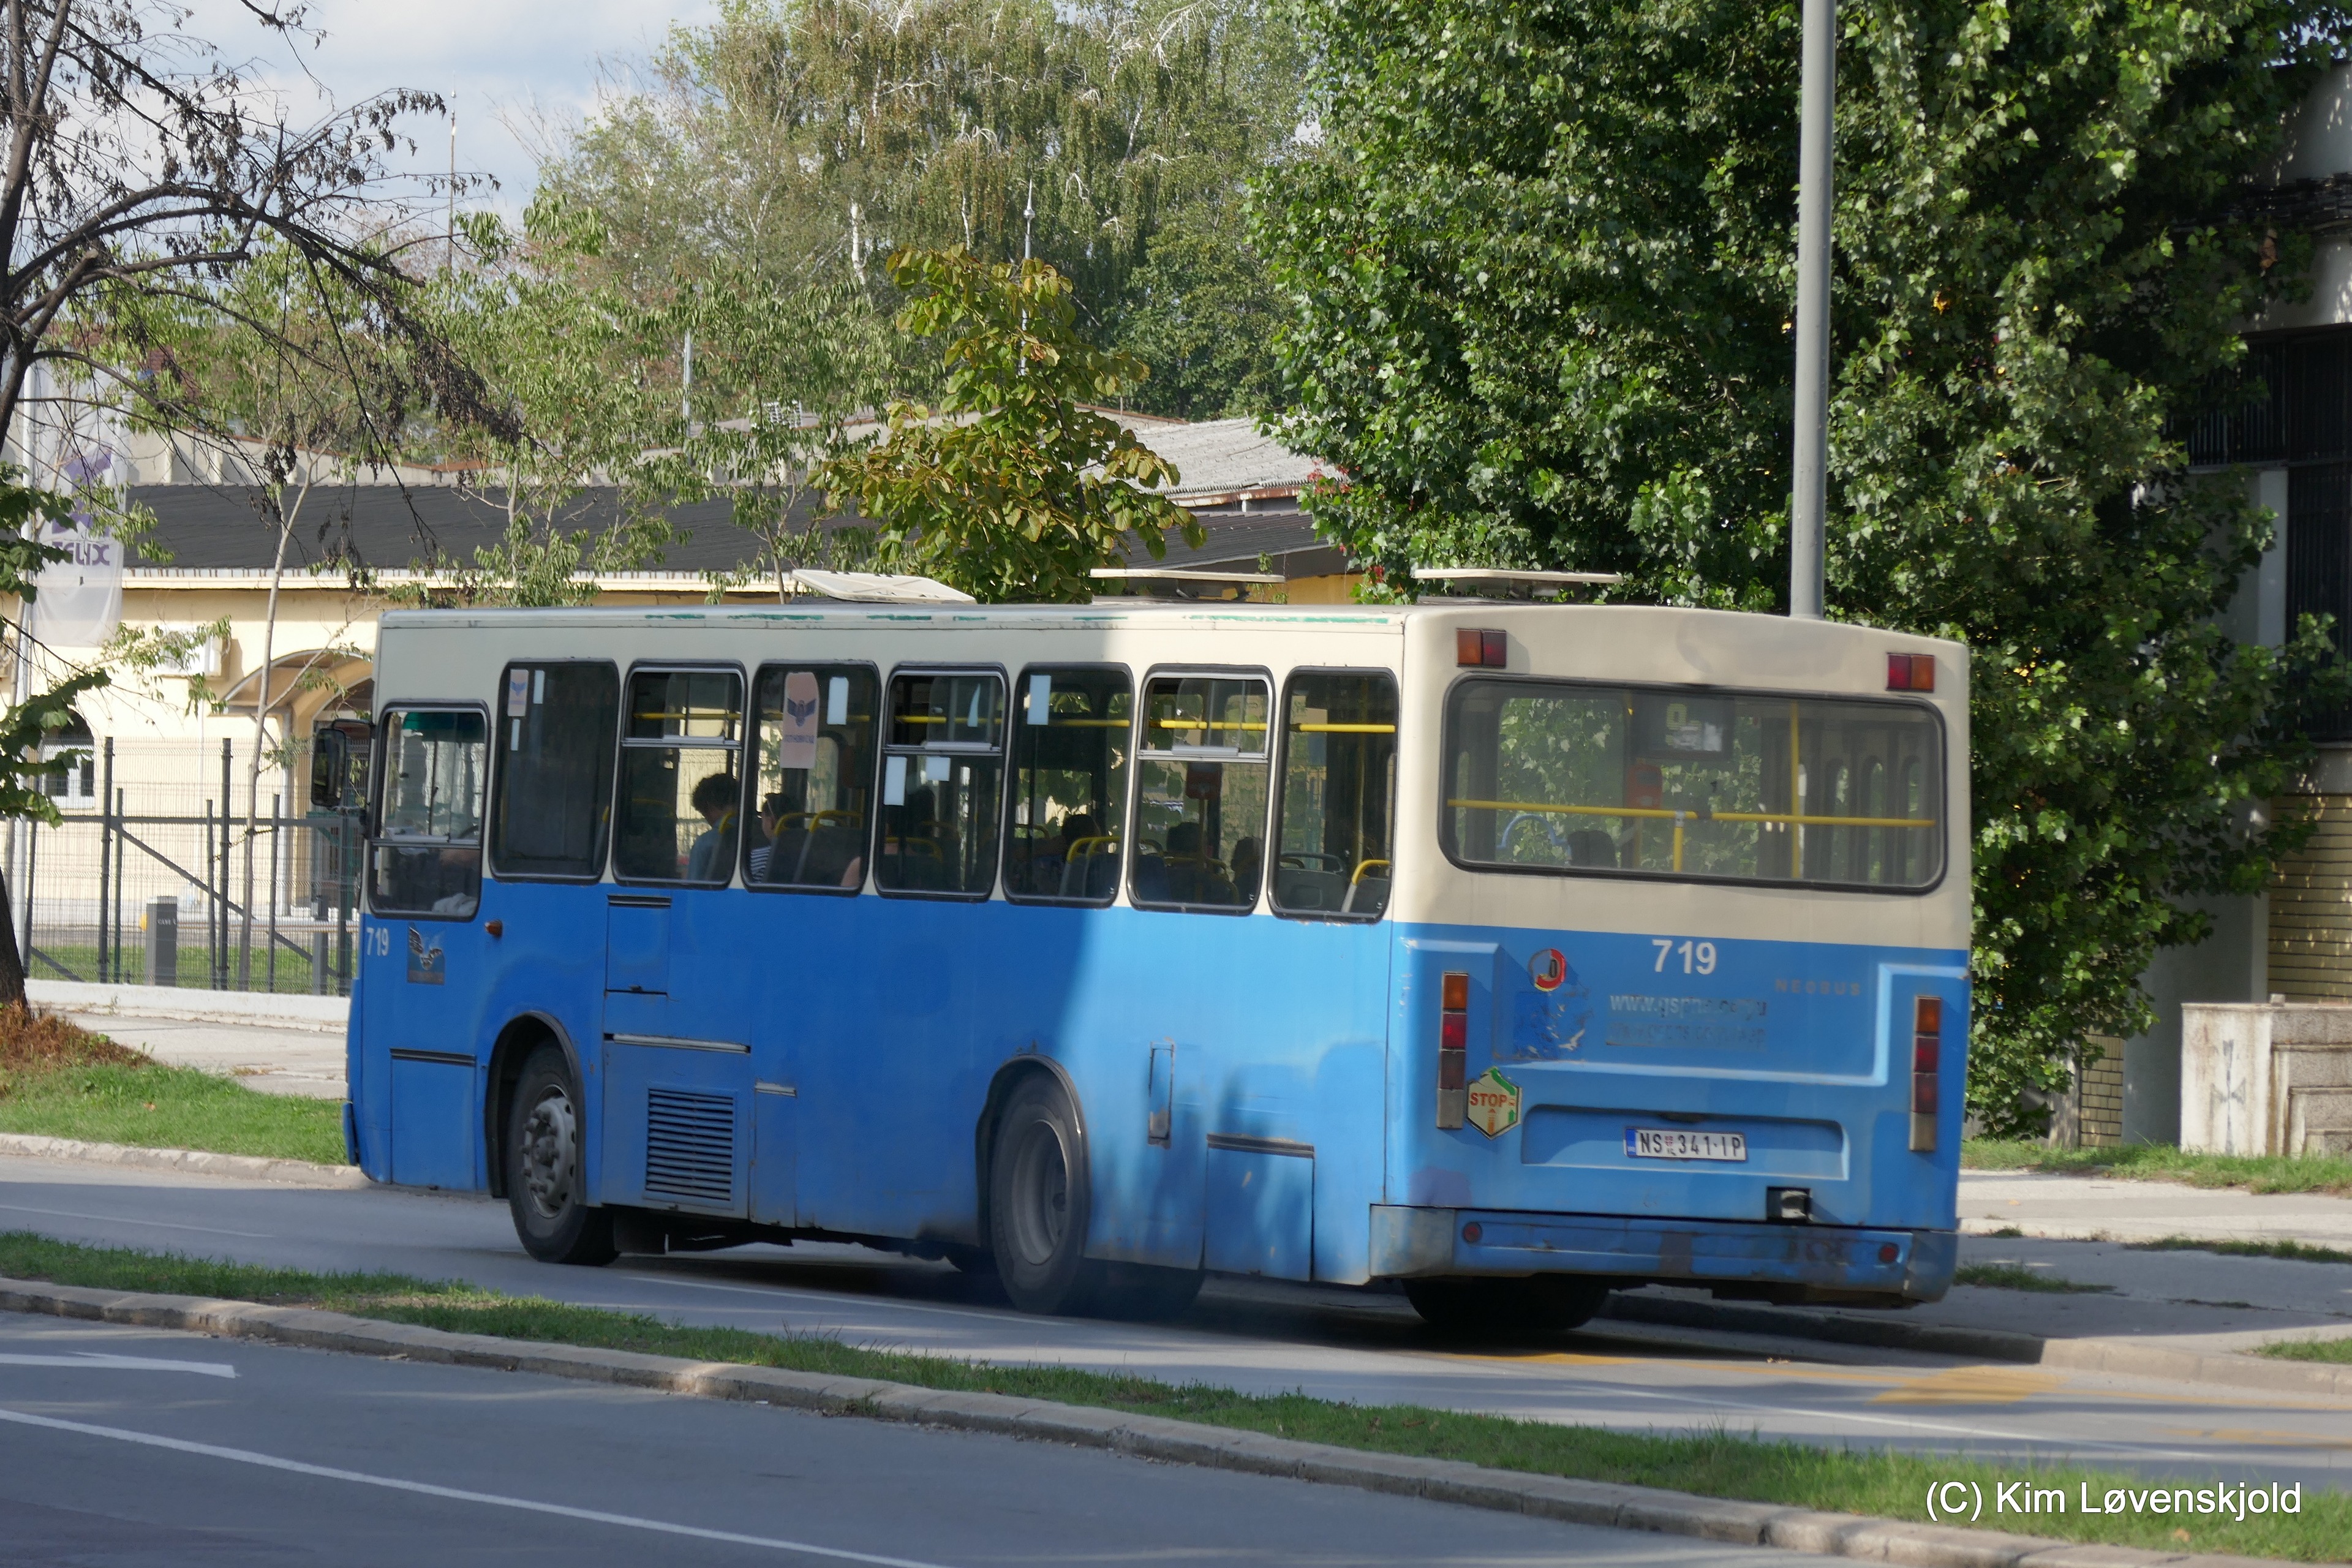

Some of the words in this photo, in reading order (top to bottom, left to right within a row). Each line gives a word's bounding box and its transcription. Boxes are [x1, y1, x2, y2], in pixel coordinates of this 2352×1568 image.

[366, 927, 390, 957] 719
[1652, 938, 1717, 975] 719
[1775, 978, 1861, 997] NEOBUS
[1469, 1092, 1507, 1108] STOP
[1640, 1133, 1662, 1153] NS
